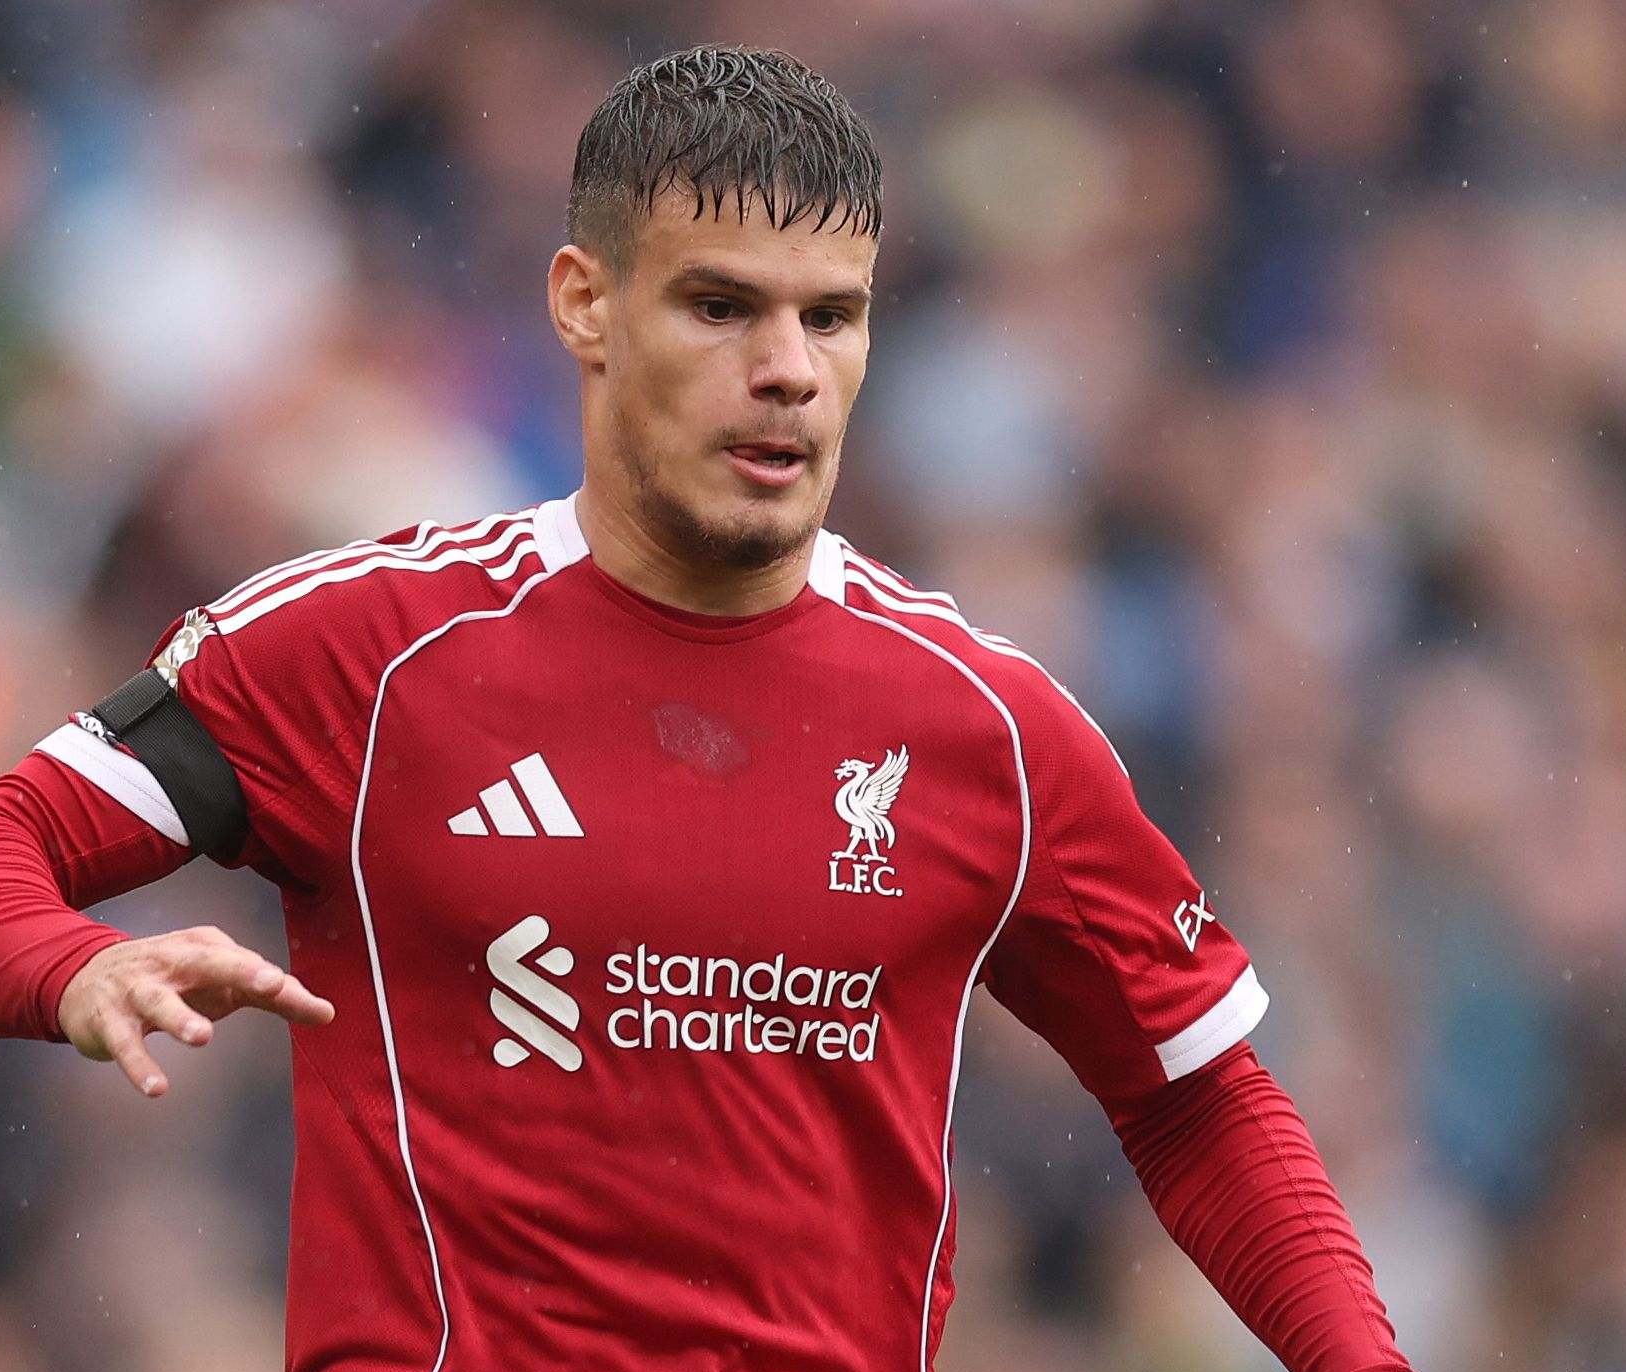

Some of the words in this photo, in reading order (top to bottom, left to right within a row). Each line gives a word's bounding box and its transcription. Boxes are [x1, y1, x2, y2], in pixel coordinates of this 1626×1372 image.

[828, 860, 904, 897] L.F.C.
[605, 943, 883, 1010] standard
[607, 998, 879, 1063] chartered
